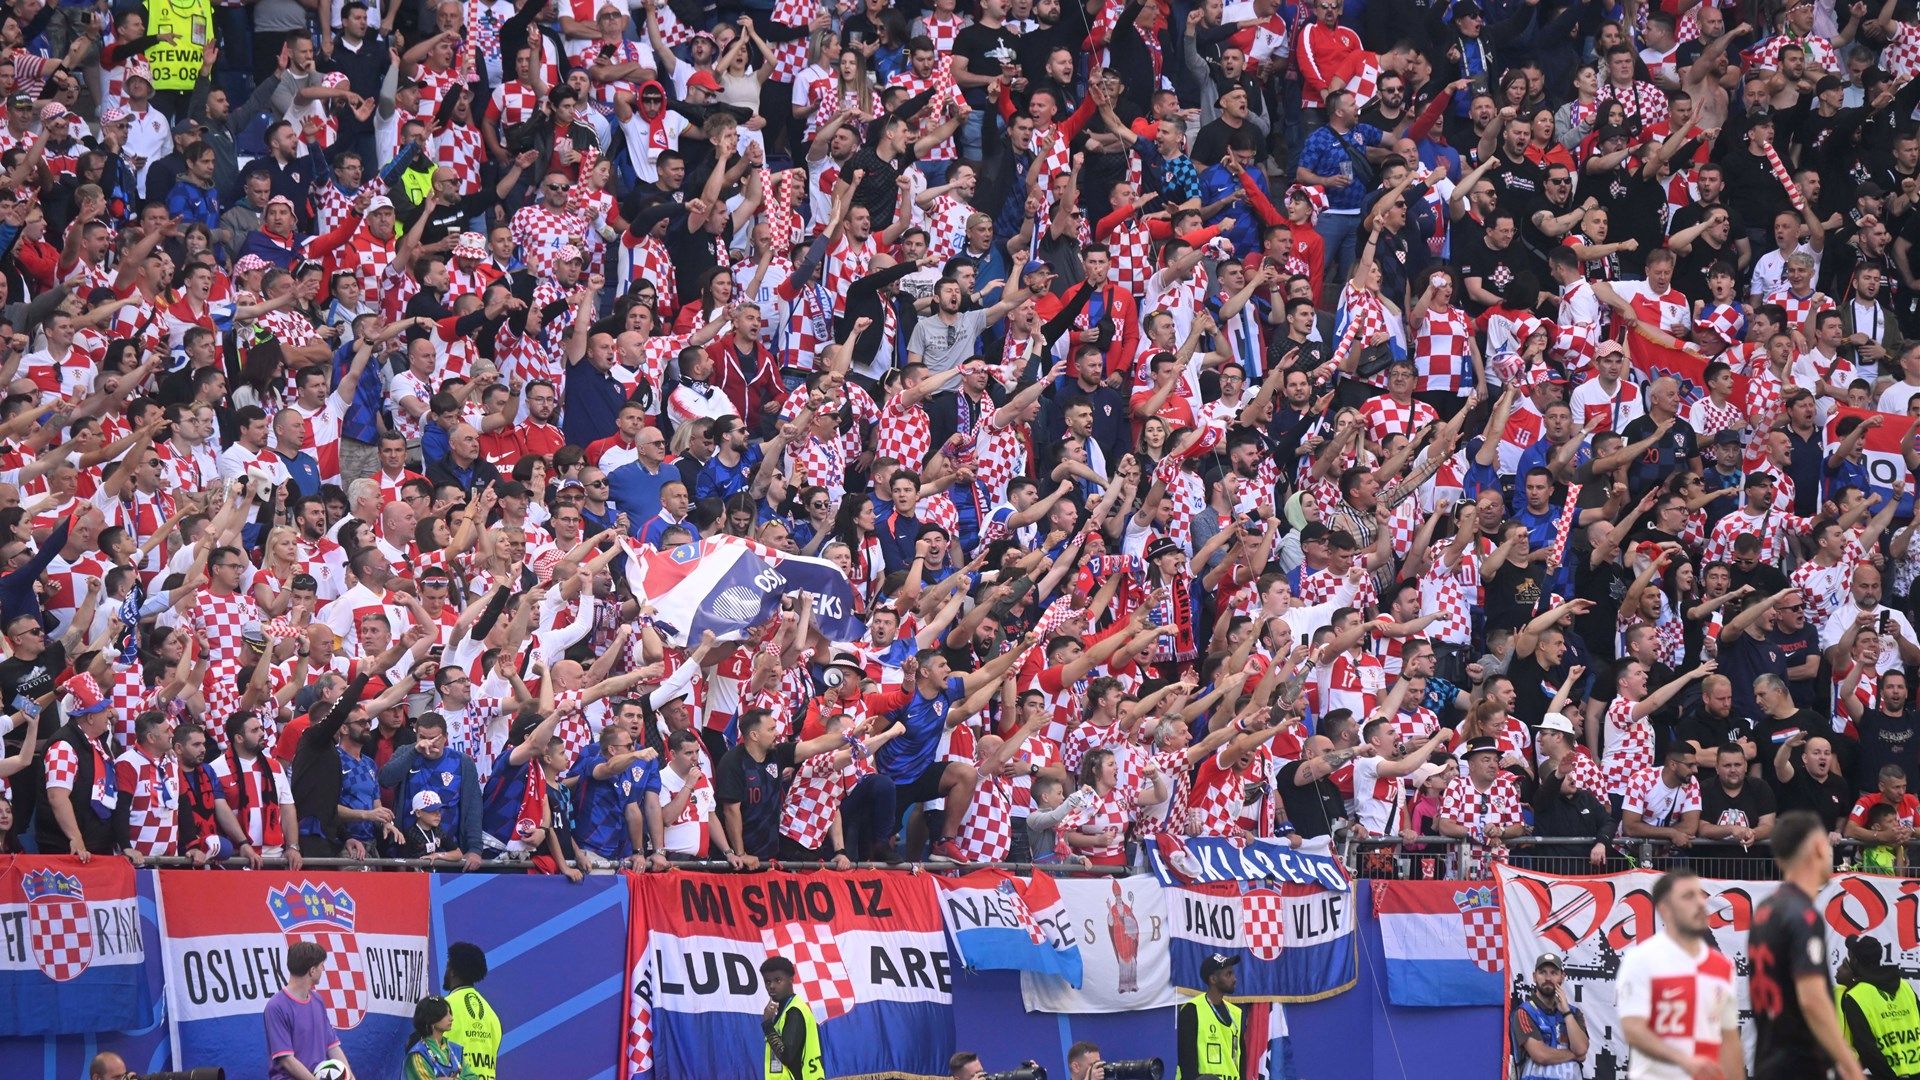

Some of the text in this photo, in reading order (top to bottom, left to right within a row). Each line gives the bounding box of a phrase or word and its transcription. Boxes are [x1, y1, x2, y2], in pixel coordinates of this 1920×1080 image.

[148, 49, 203, 63] STEWA
[152, 67, 199, 81] 03-08
[551, 237, 560, 249] 4
[1642, 448, 1660, 464] 20
[731, 659, 742, 676] 4
[1341, 671, 1357, 688] 17
[746, 787, 761, 804] 10
[682, 879, 892, 927] MI SMO IZ
[1185, 897, 1236, 941] JAKO
[1084, 915, 1162, 945] S B
[183, 947, 289, 1005] OSIJEK
[656, 949, 758, 995] LUD
[1656, 1001, 1687, 1034] 22
